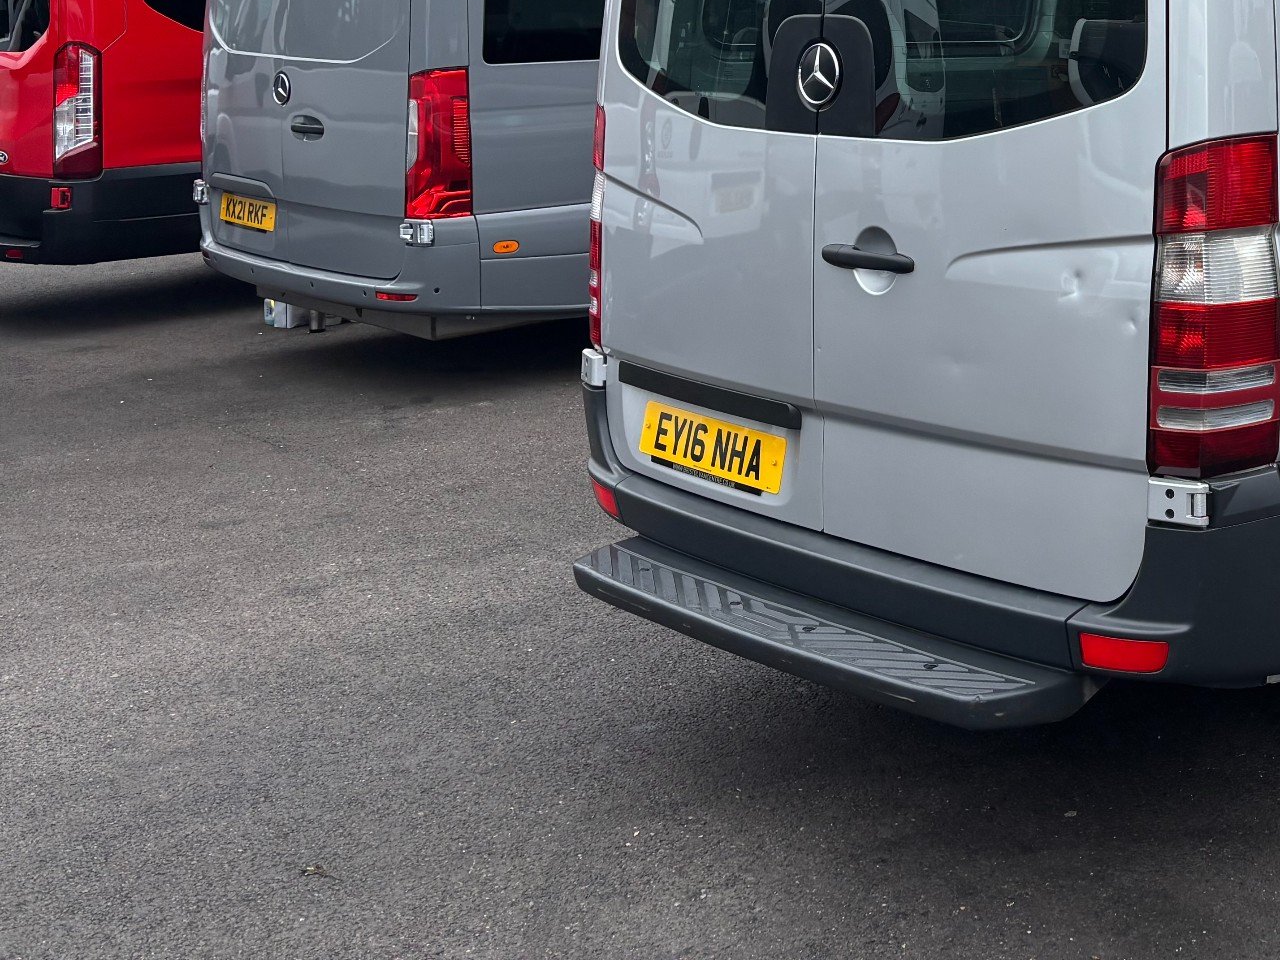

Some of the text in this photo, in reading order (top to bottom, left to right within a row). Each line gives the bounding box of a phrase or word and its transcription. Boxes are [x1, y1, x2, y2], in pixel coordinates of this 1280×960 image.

[225, 197, 268, 225] KX21 RKF
[654, 411, 762, 481] EY16 NHA
